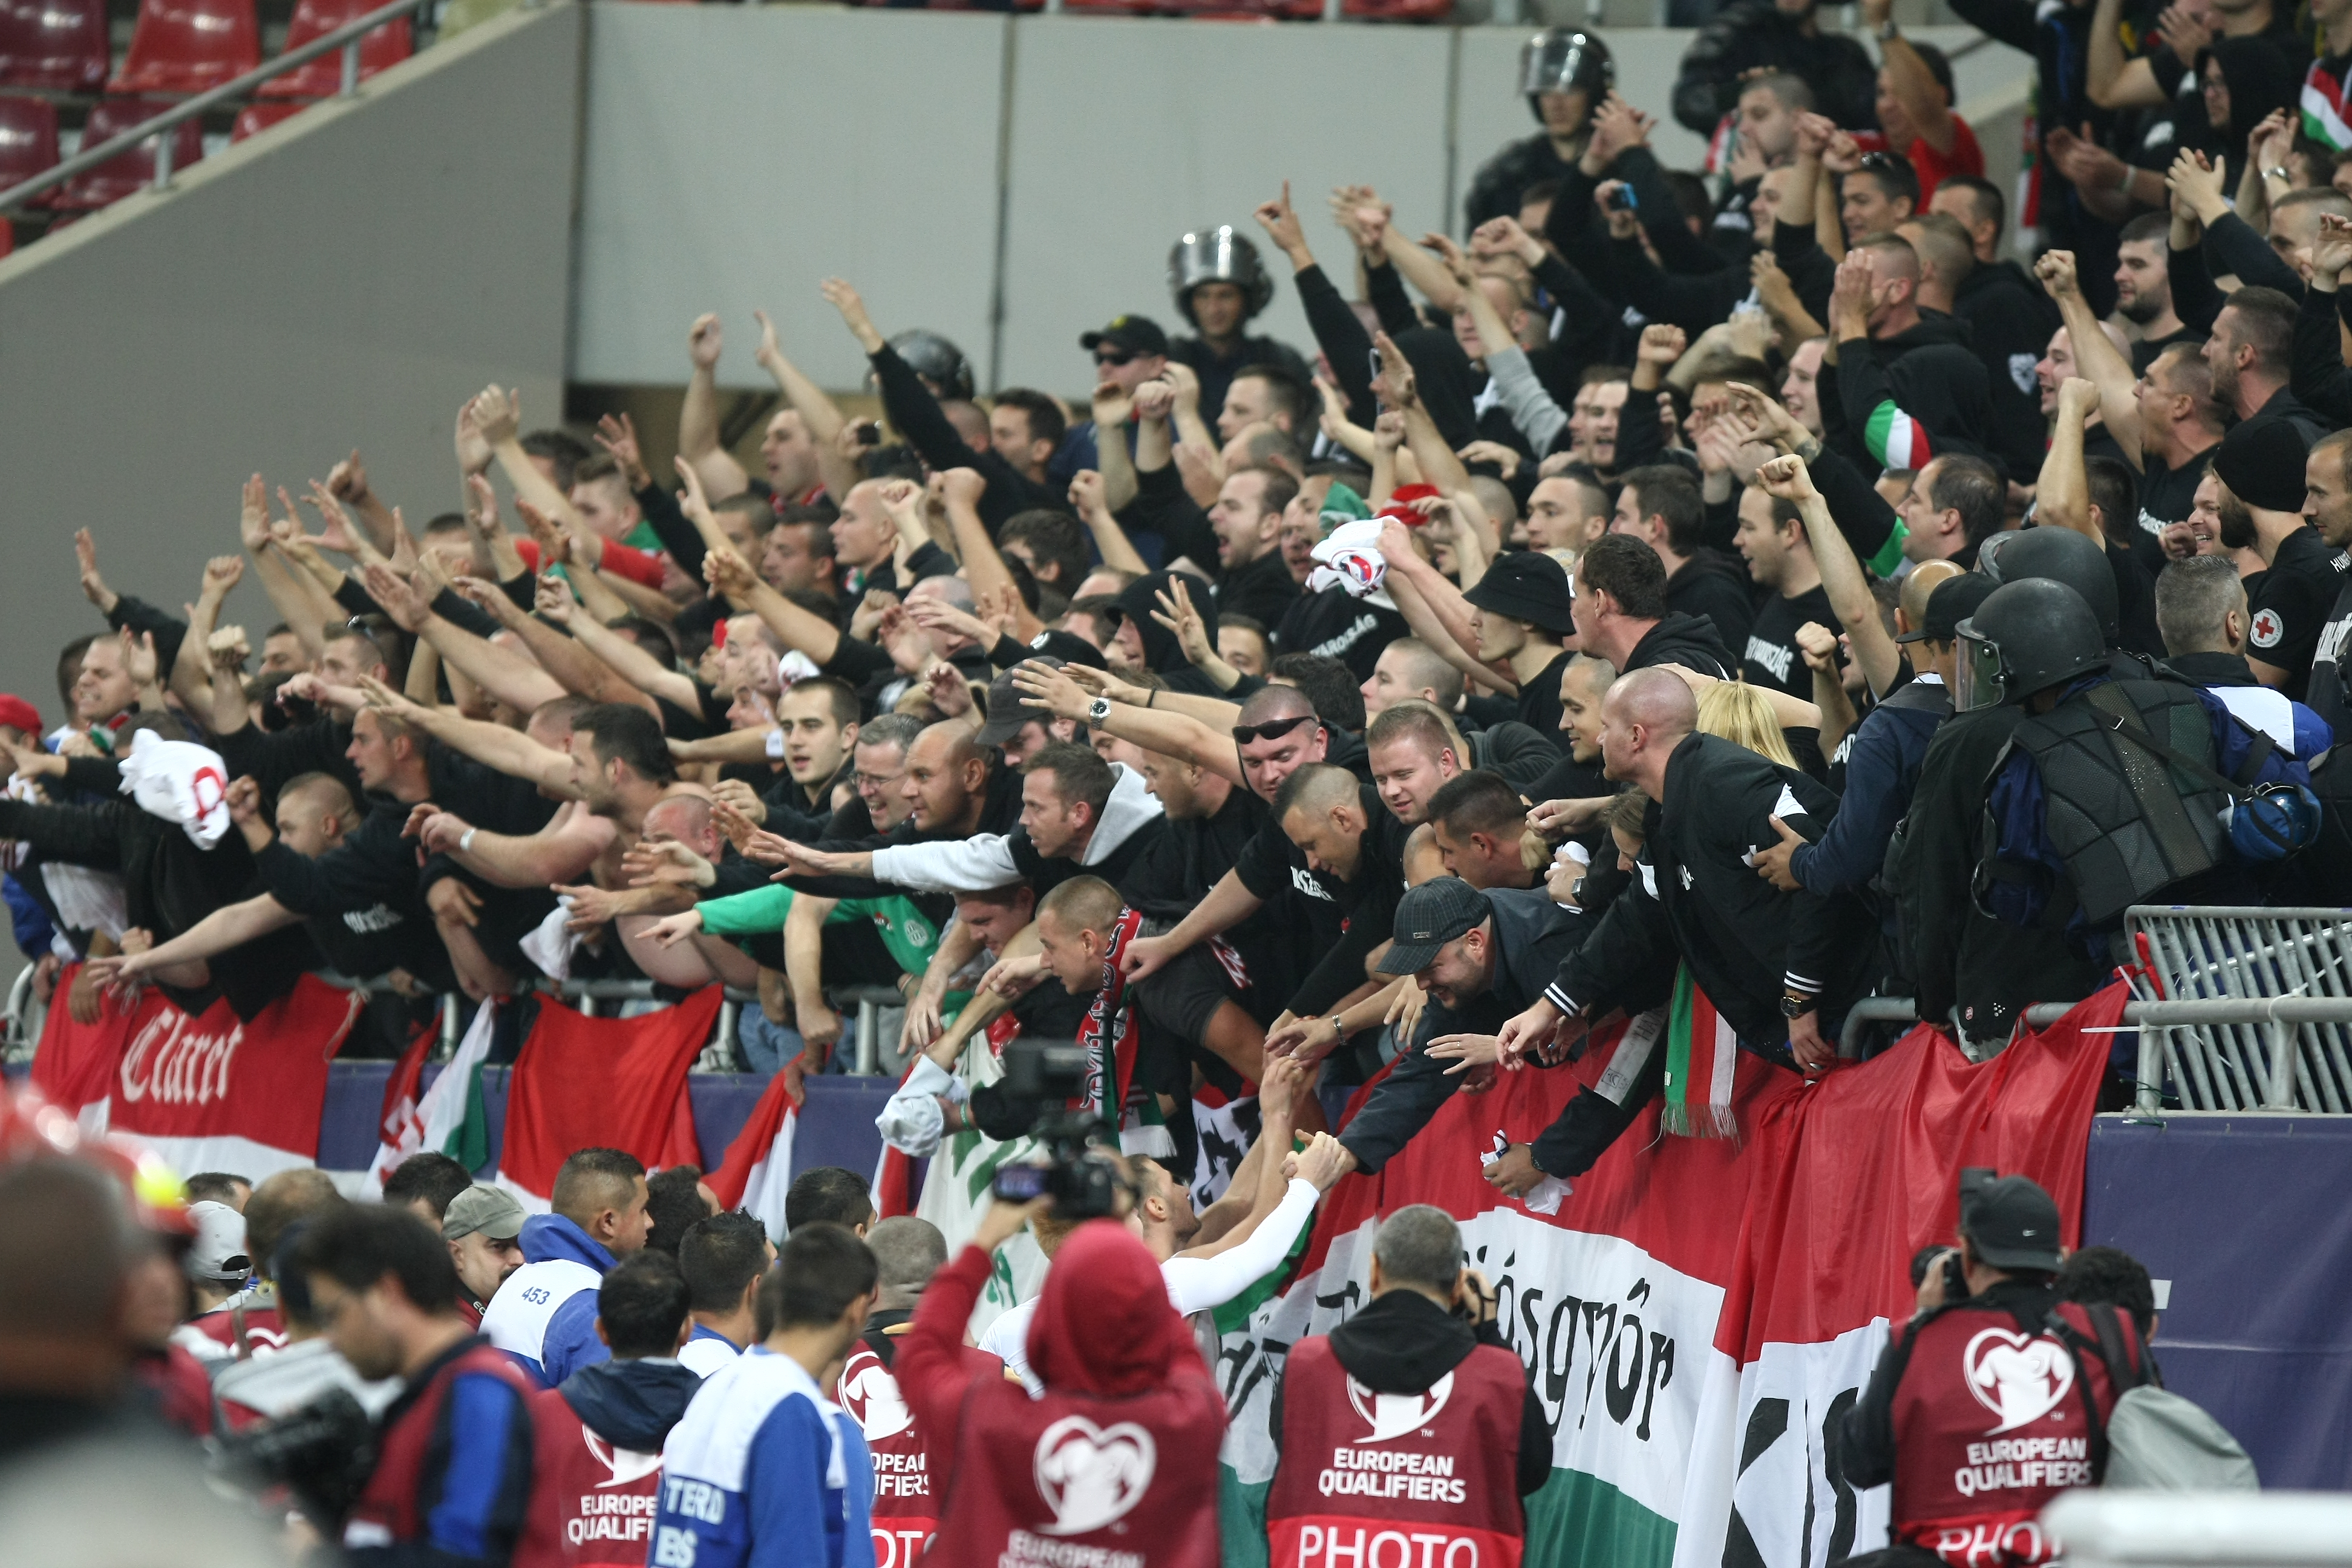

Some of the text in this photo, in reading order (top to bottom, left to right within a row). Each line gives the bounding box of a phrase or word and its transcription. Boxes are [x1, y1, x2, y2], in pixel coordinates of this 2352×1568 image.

[521, 1287, 550, 1305] 453
[1333, 1447, 1454, 1477] EUROPEAN
[1967, 1437, 2087, 1466] EUROPEAN
[1318, 1469, 1467, 1504] QUALIFIERS
[1955, 1460, 2092, 1497] QUALIFIERS
[580, 1494, 658, 1517] EUROPE
[1298, 1524, 1479, 1568] PHOTO
